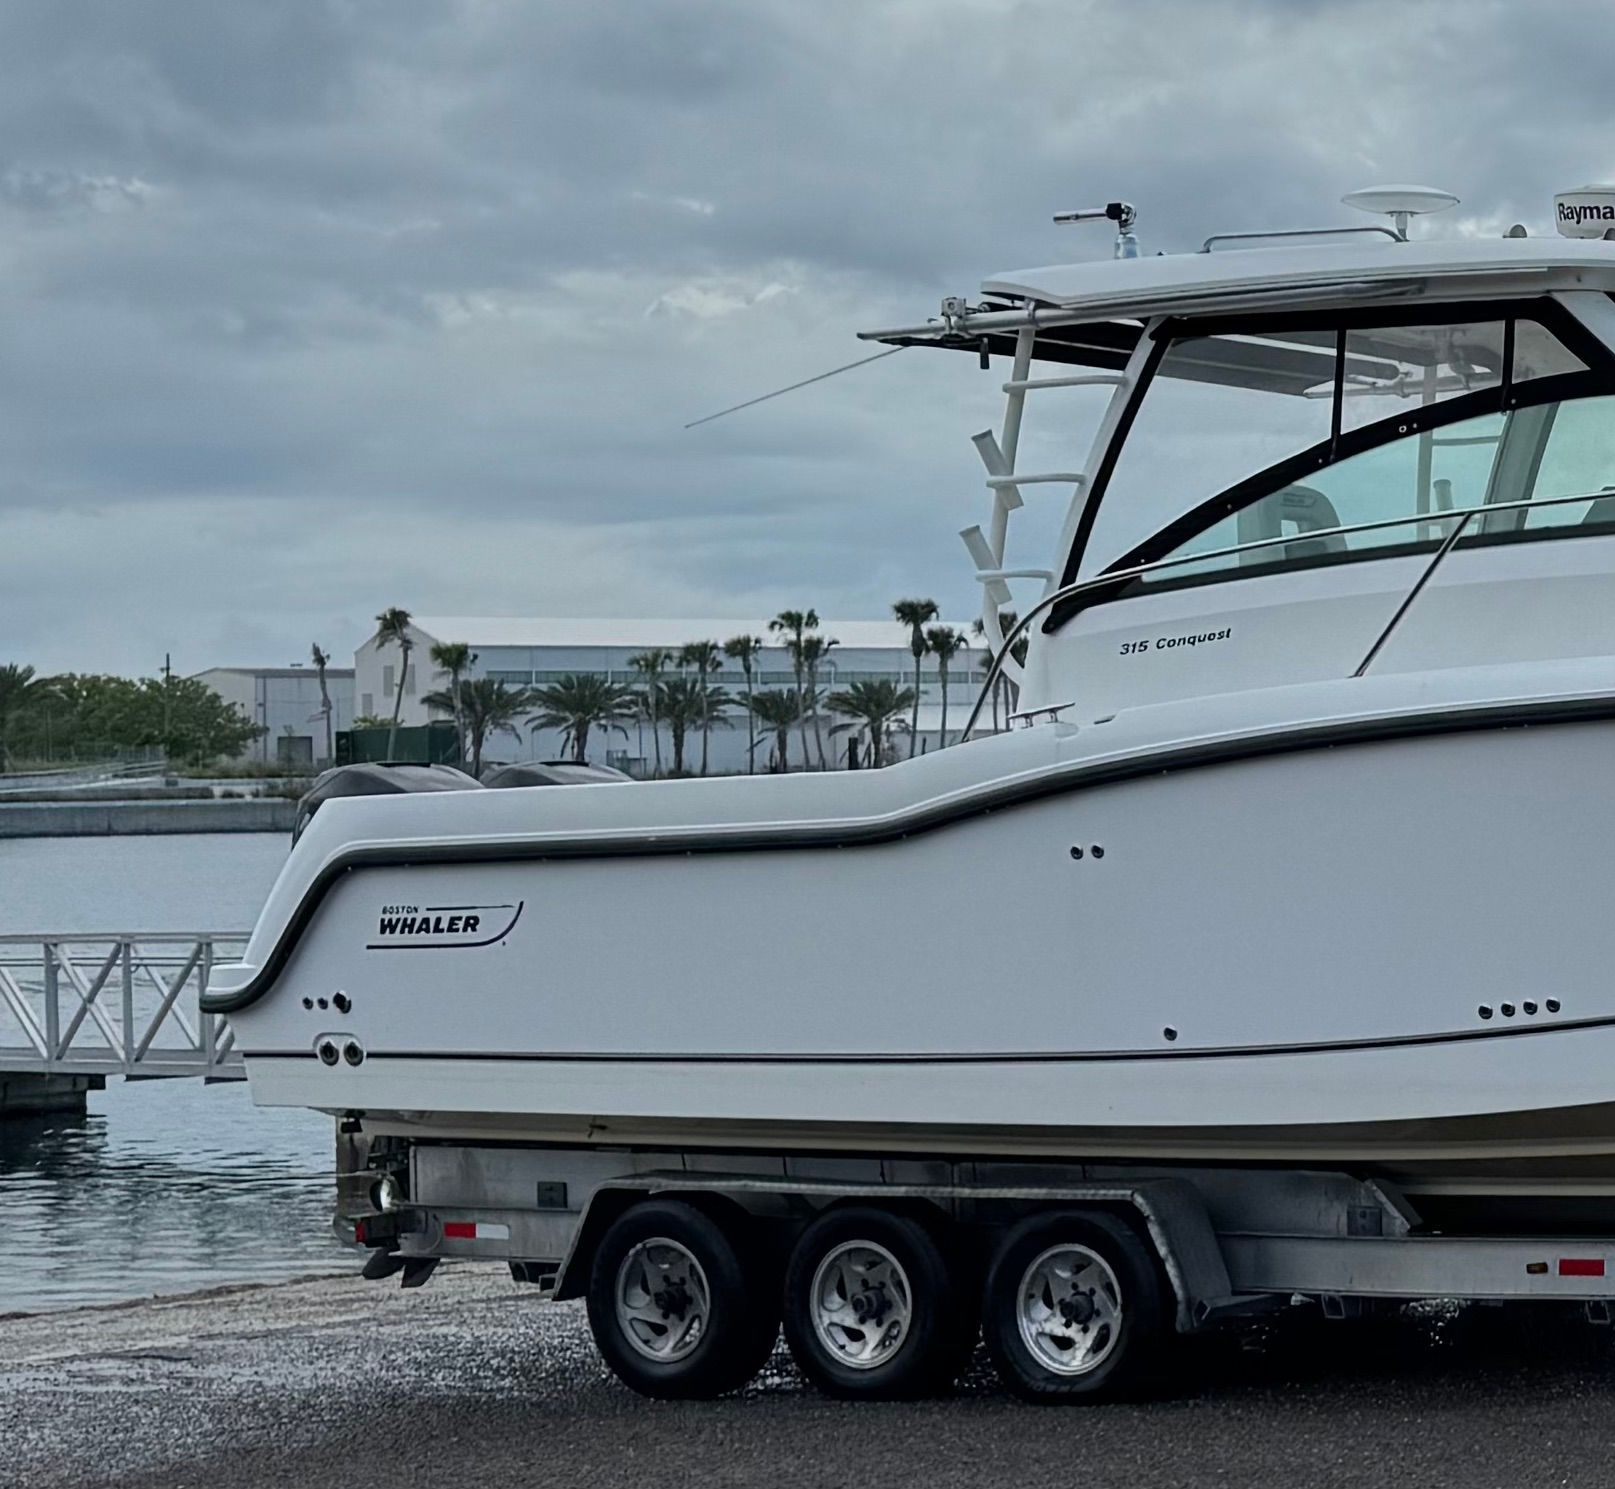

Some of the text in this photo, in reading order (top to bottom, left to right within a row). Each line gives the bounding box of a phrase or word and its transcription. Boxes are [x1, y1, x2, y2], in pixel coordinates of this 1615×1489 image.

[1119, 628, 1232, 655] 315 Conquest
[381, 905, 420, 915] BOSTON
[379, 915, 480, 935] WHALER
